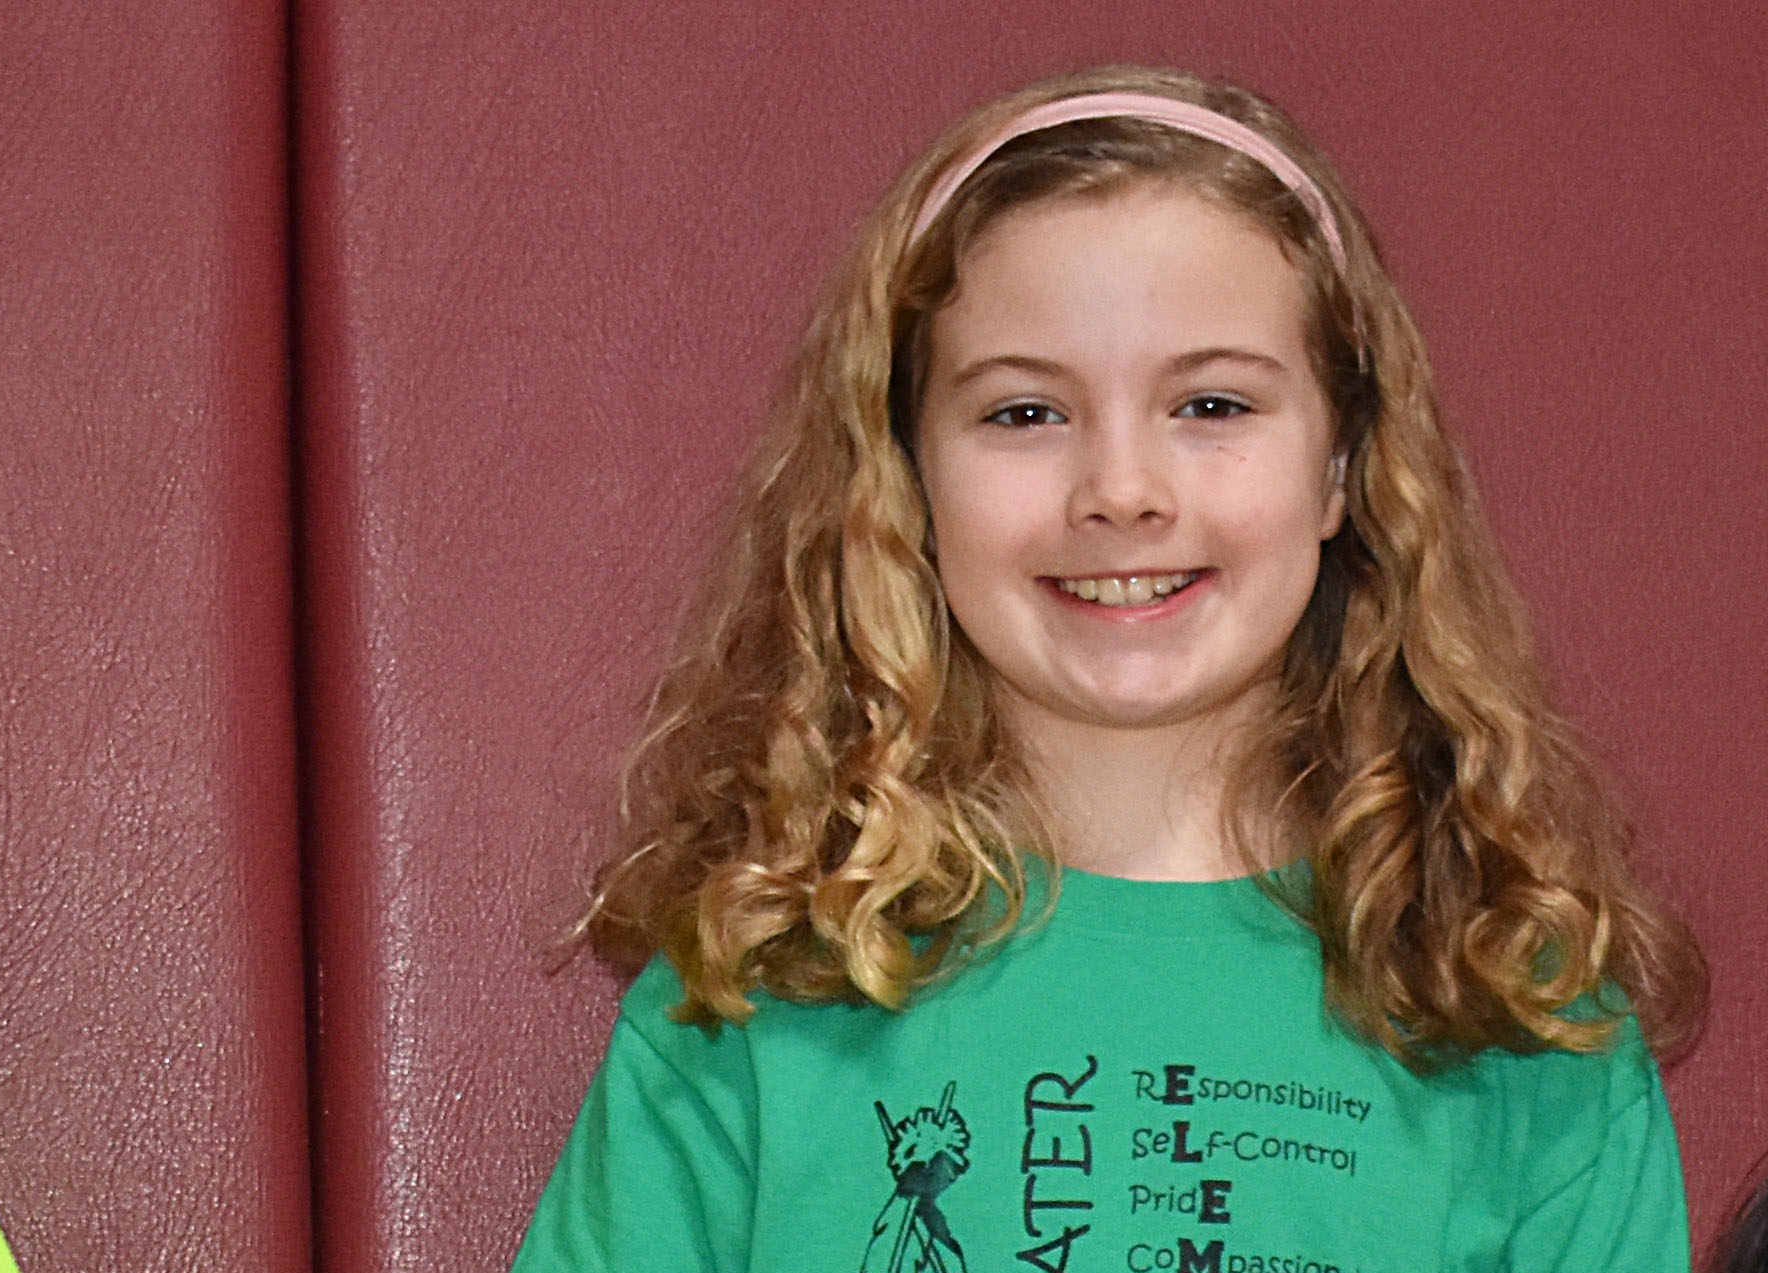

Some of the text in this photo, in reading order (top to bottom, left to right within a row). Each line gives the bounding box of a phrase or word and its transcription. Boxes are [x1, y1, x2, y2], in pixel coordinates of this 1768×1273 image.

[1132, 1064, 1371, 1124] REsponsibility
[1132, 1120, 1356, 1177] SeLf-Control
[1128, 1179, 1232, 1224] PridE
